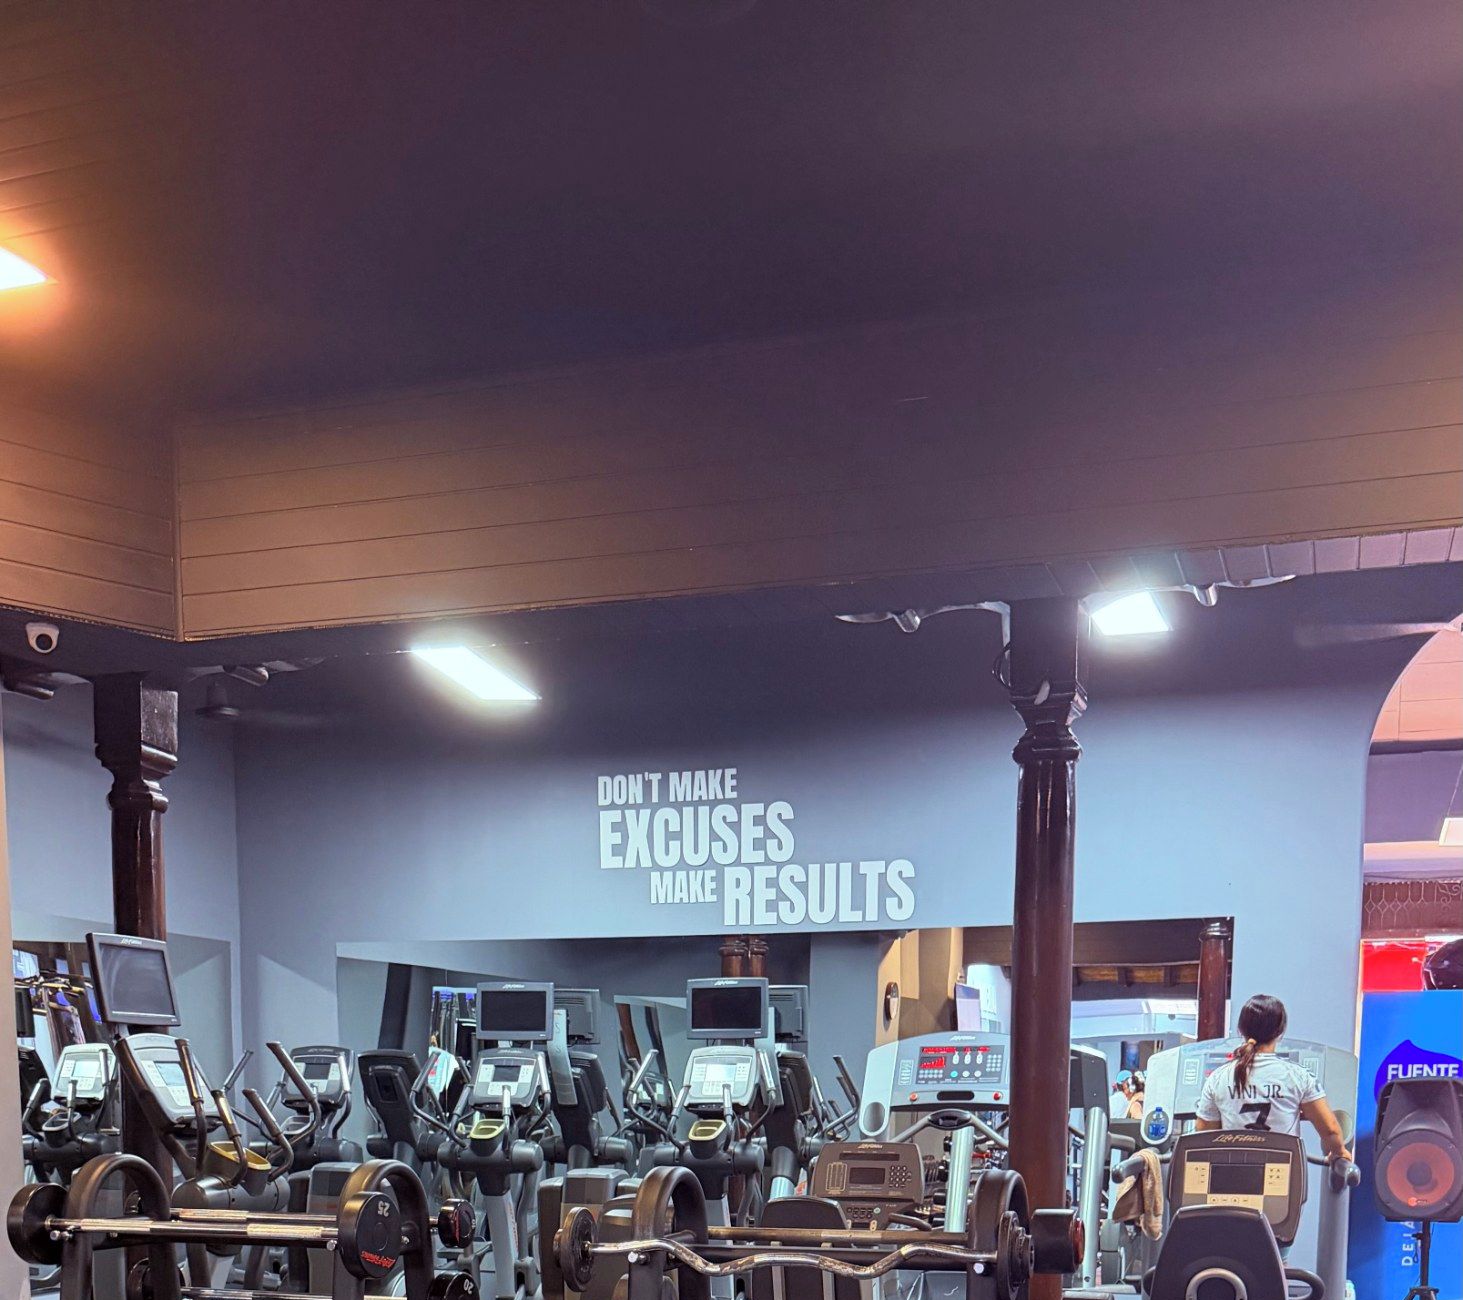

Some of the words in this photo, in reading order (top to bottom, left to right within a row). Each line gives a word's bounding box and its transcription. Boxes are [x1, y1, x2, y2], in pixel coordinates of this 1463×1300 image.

[597, 772, 662, 806] DON'T
[668, 768, 738, 802] MAKE
[599, 801, 795, 869] EXCUSES
[650, 869, 717, 904] MAKE
[723, 859, 916, 926] RESULTS
[1239, 1102, 1272, 1131] 7
[377, 1200, 390, 1218] 25
[463, 1278, 475, 1295] 20
